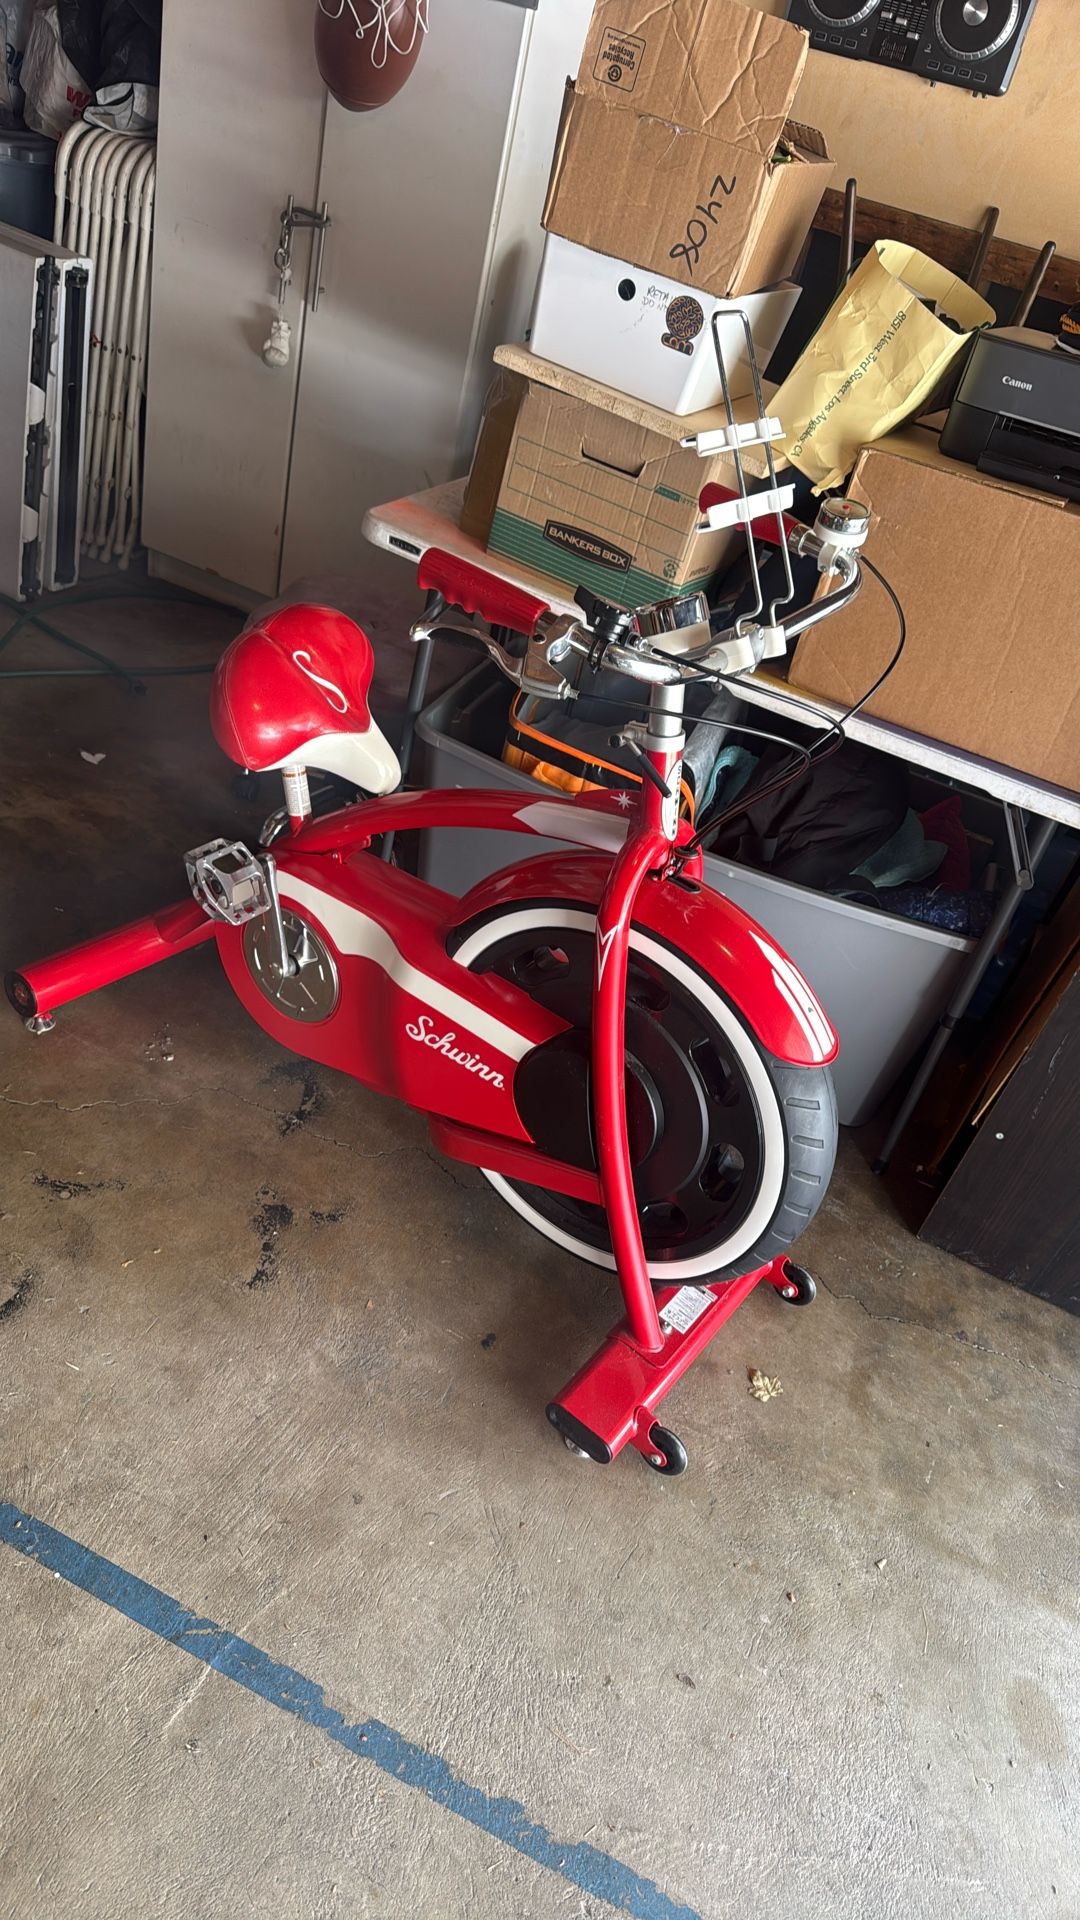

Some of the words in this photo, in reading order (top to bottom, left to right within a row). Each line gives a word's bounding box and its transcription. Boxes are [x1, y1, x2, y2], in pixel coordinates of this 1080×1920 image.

[602, 51, 635, 70] Corrugated
[609, 43, 634, 60] Recycles
[891, 310, 907, 332] 8151
[873, 329, 895, 353] West
[860, 351, 877, 372] 3rd
[1002, 375, 1033, 392] Canon
[825, 395, 841, 413] Los
[790, 443, 804, 458] CA
[548, 526, 602, 556] BANKERS
[602, 549, 627, 567] BOX
[405, 1015, 505, 1089] Schwinn
